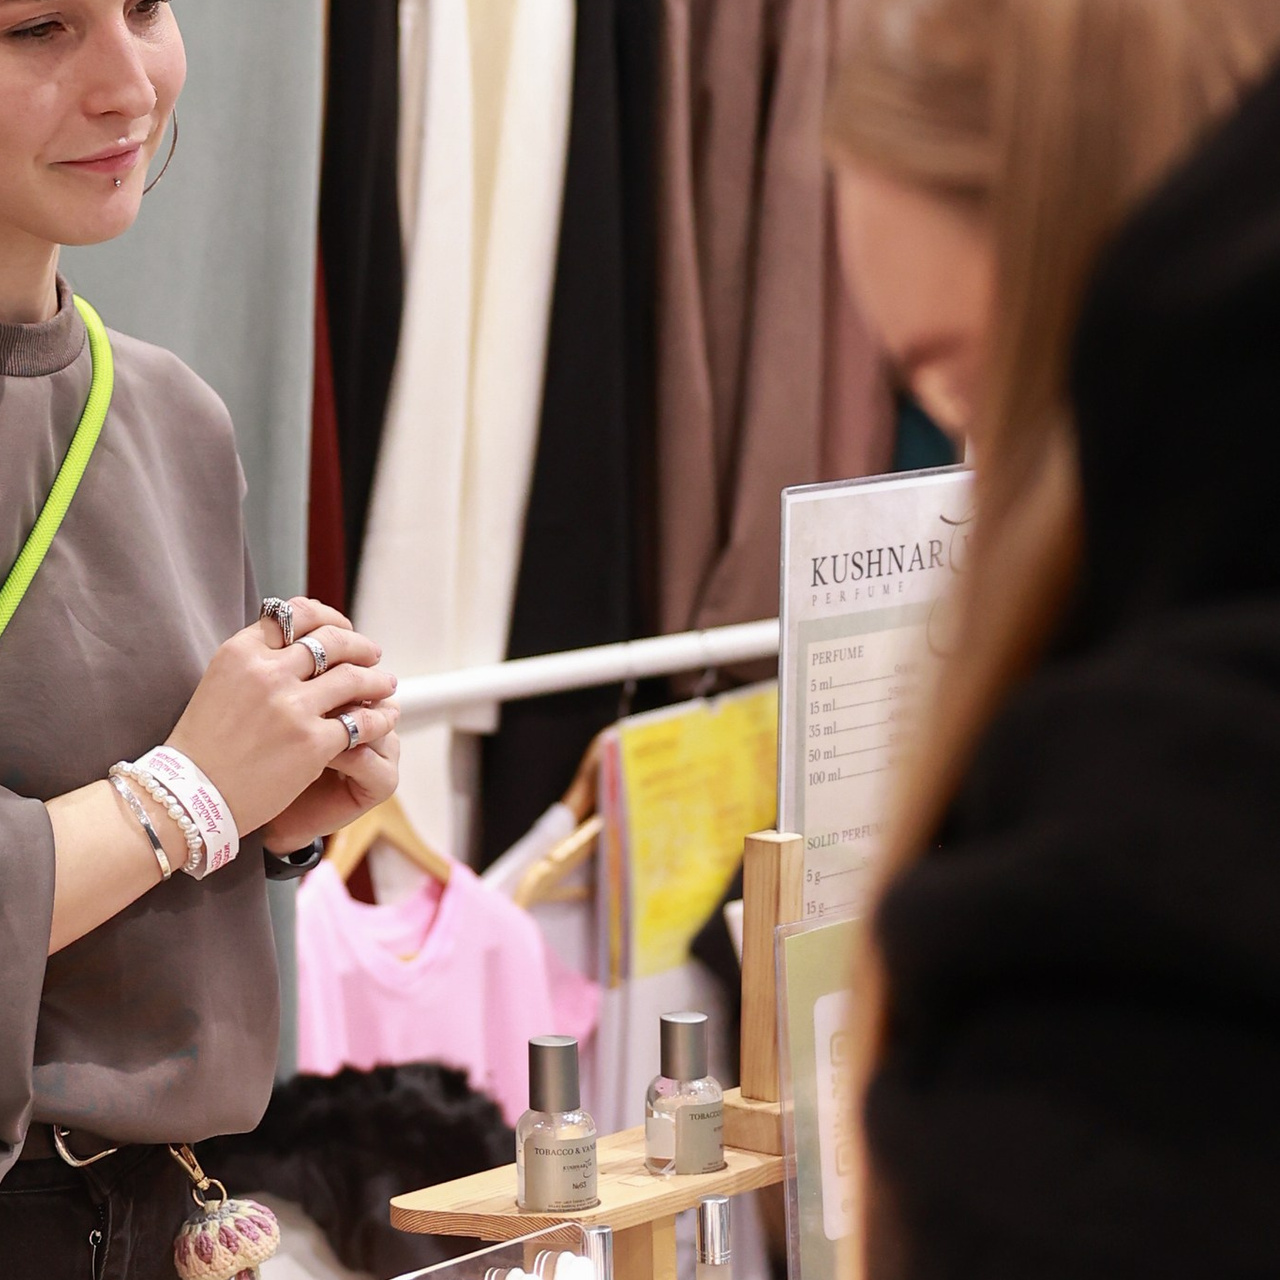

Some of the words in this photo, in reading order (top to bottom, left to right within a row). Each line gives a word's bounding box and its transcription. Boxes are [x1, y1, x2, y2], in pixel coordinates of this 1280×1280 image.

[811, 581, 904, 607] PERFUME
[811, 645, 865, 666] PERFUME
[810, 679, 817, 692] 5
[819, 676, 832, 691] ml
[810, 701, 820, 715] 15
[822, 698, 836, 713] ml
[808, 723, 821, 738] 35
[823, 721, 837, 735] ml
[808, 748, 821, 763] 50
[823, 745, 836, 760] ml
[809, 770, 826, 786] 100
[827, 767, 841, 782] ml
[196, 786, 223, 821] маркет
[190, 793, 221, 834] Ламбада
[807, 832, 839, 850] SOLID
[841, 824, 884, 843] PERFU
[806, 869, 813, 883] 5
[814, 871, 821, 886] g
[807, 901, 817, 915] 15
[818, 902, 824, 918] g
[534, 1147, 574, 1156] TOBACCO
